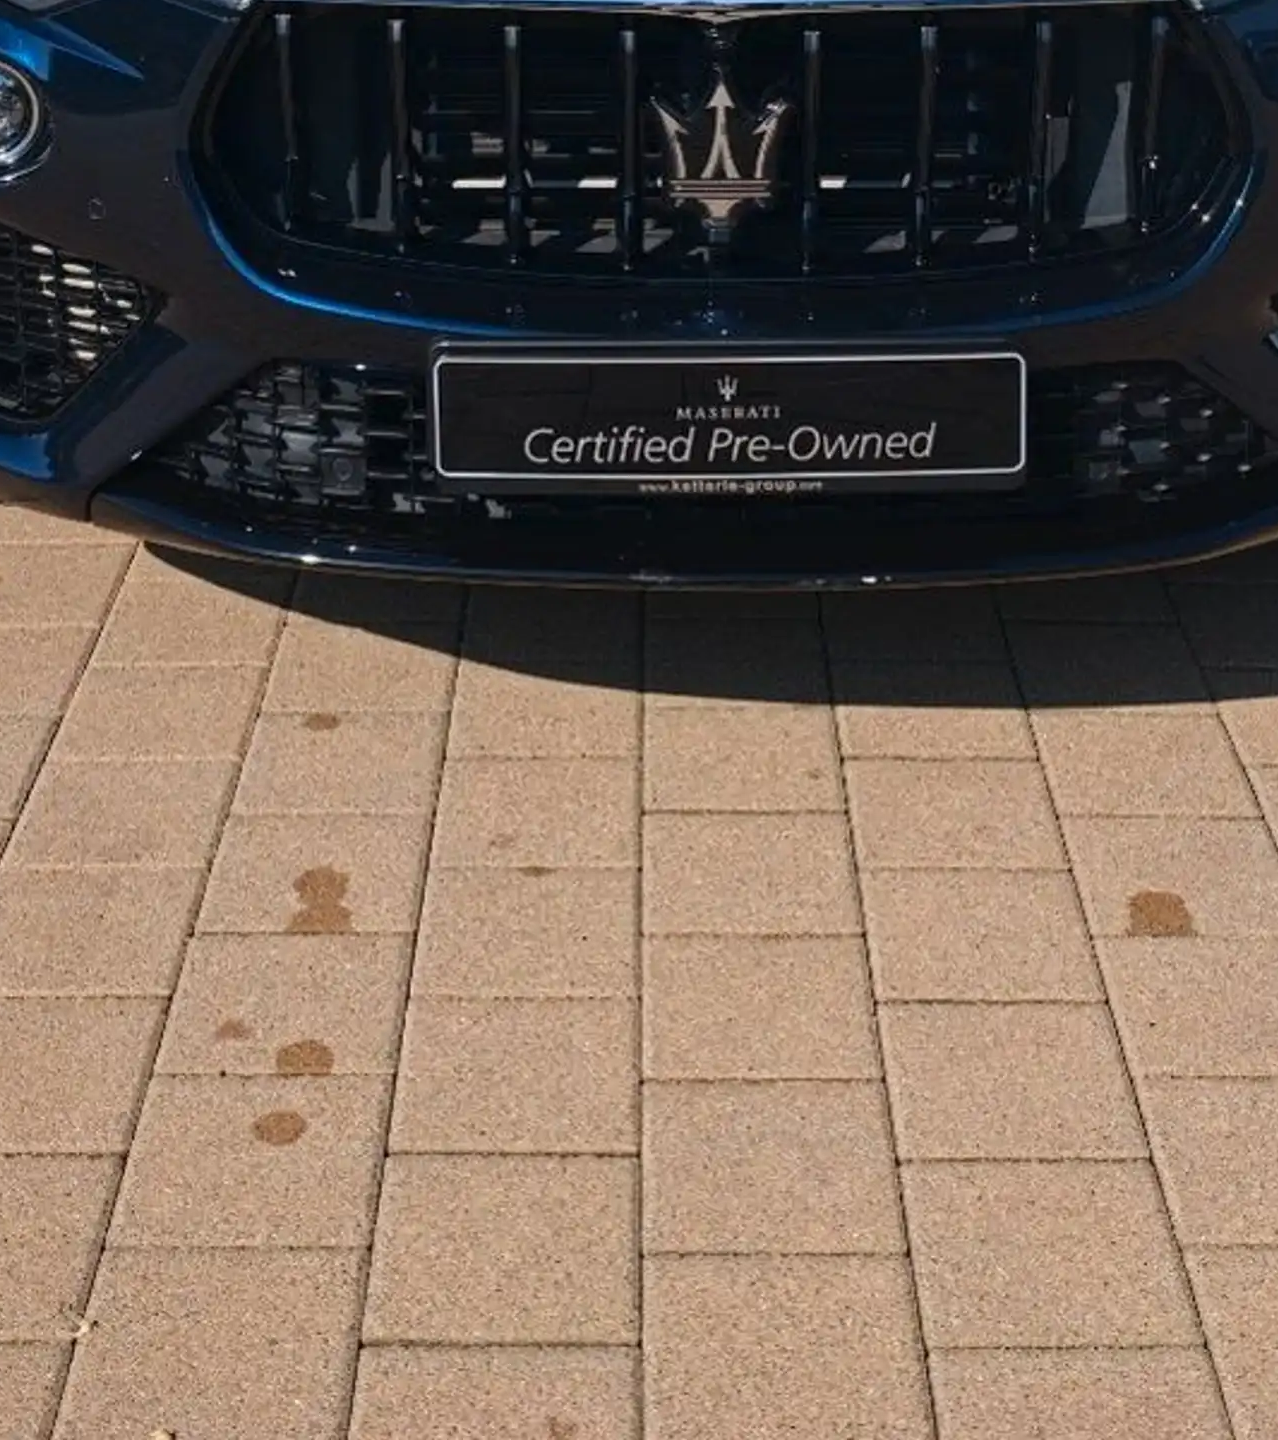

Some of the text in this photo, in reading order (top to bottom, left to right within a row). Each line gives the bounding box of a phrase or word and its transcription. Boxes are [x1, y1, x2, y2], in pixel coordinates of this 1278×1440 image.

[675, 405, 782, 420] MASERATI
[523, 421, 937, 463] Certified Pre-Owned
